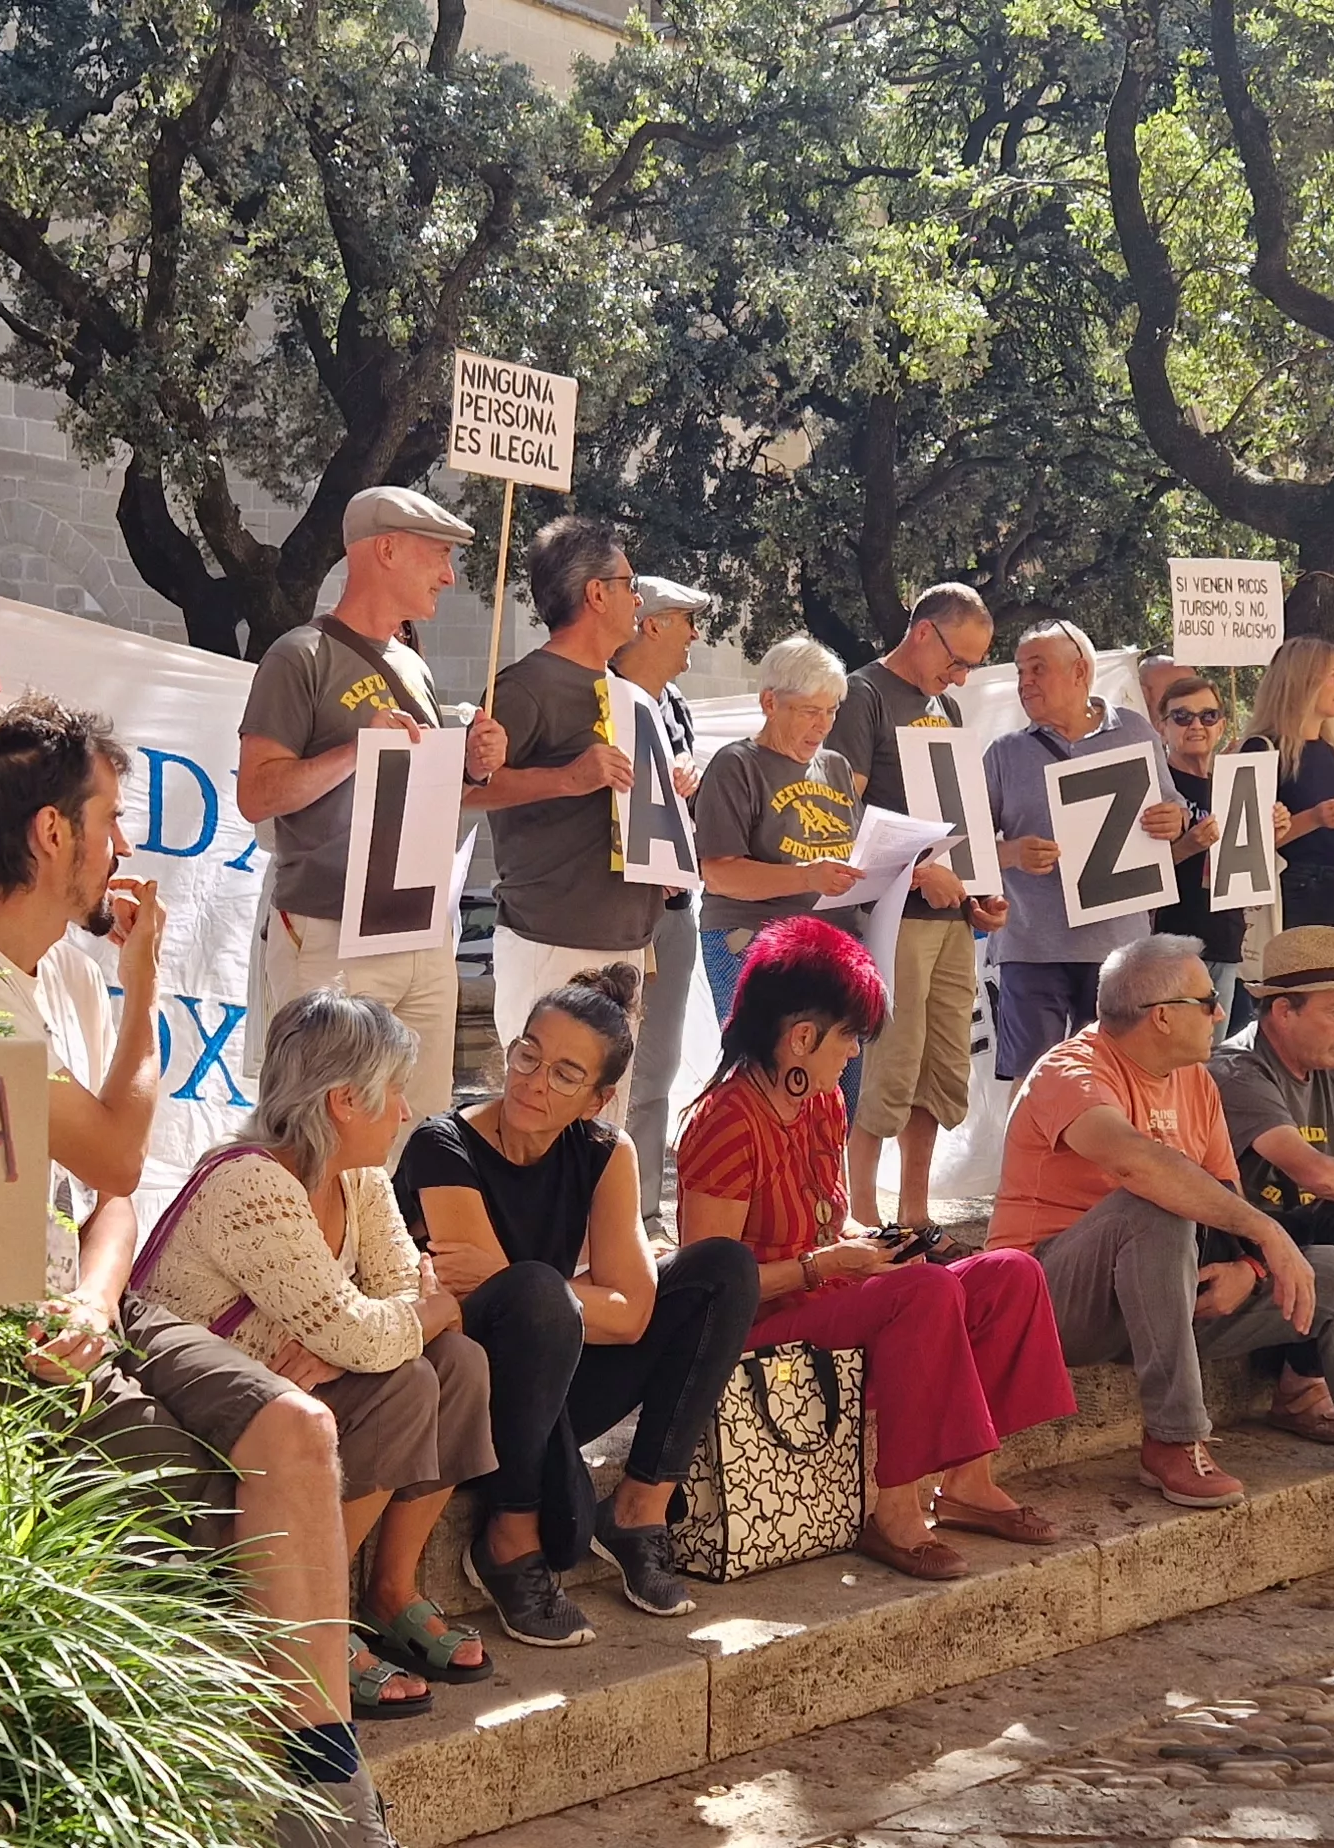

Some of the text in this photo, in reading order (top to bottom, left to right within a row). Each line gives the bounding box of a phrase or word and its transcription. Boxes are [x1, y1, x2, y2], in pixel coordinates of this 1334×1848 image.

[460, 359, 555, 406] NINGUNA
[459, 390, 557, 437] PERSONA
[453, 423, 560, 472] ES ILEGAL
[1176, 576, 1269, 595] SI VIENEN RICOS
[1179, 599, 1269, 620] TURISMO, SI NO,
[1177, 619, 1277, 640] ABUSO Y RACISMO
